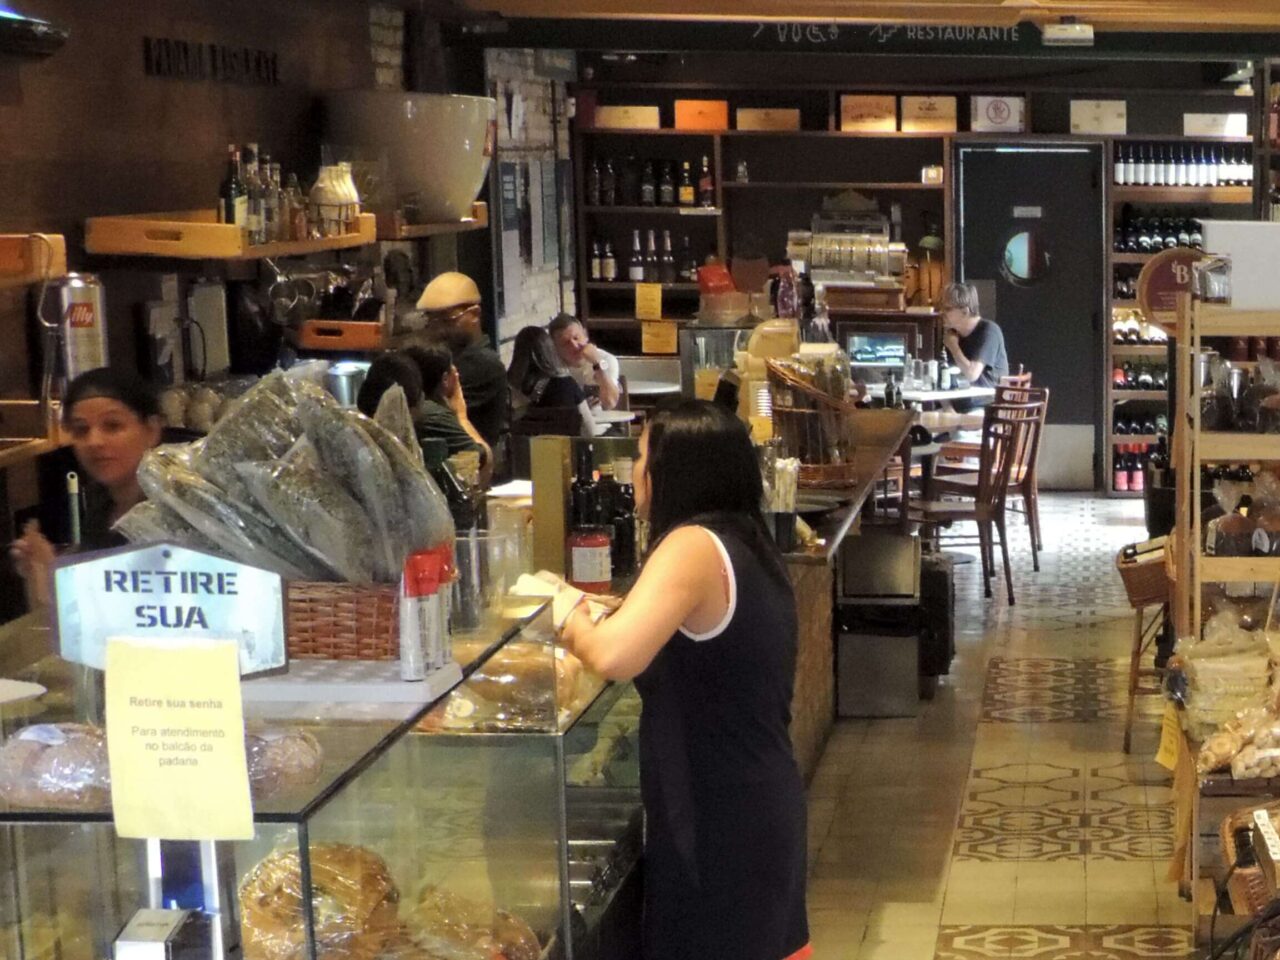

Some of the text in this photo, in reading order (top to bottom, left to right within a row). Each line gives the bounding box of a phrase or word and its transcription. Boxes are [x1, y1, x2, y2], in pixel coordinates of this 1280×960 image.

[907, 26, 1019, 41] RESTAURANTE
[103, 569, 239, 596] RETIRE
[135, 604, 209, 629] SUA
[129, 696, 223, 709] Retire sua senha
[131, 726, 225, 738] Para atendimento
[145, 741, 213, 752] no balcão da
